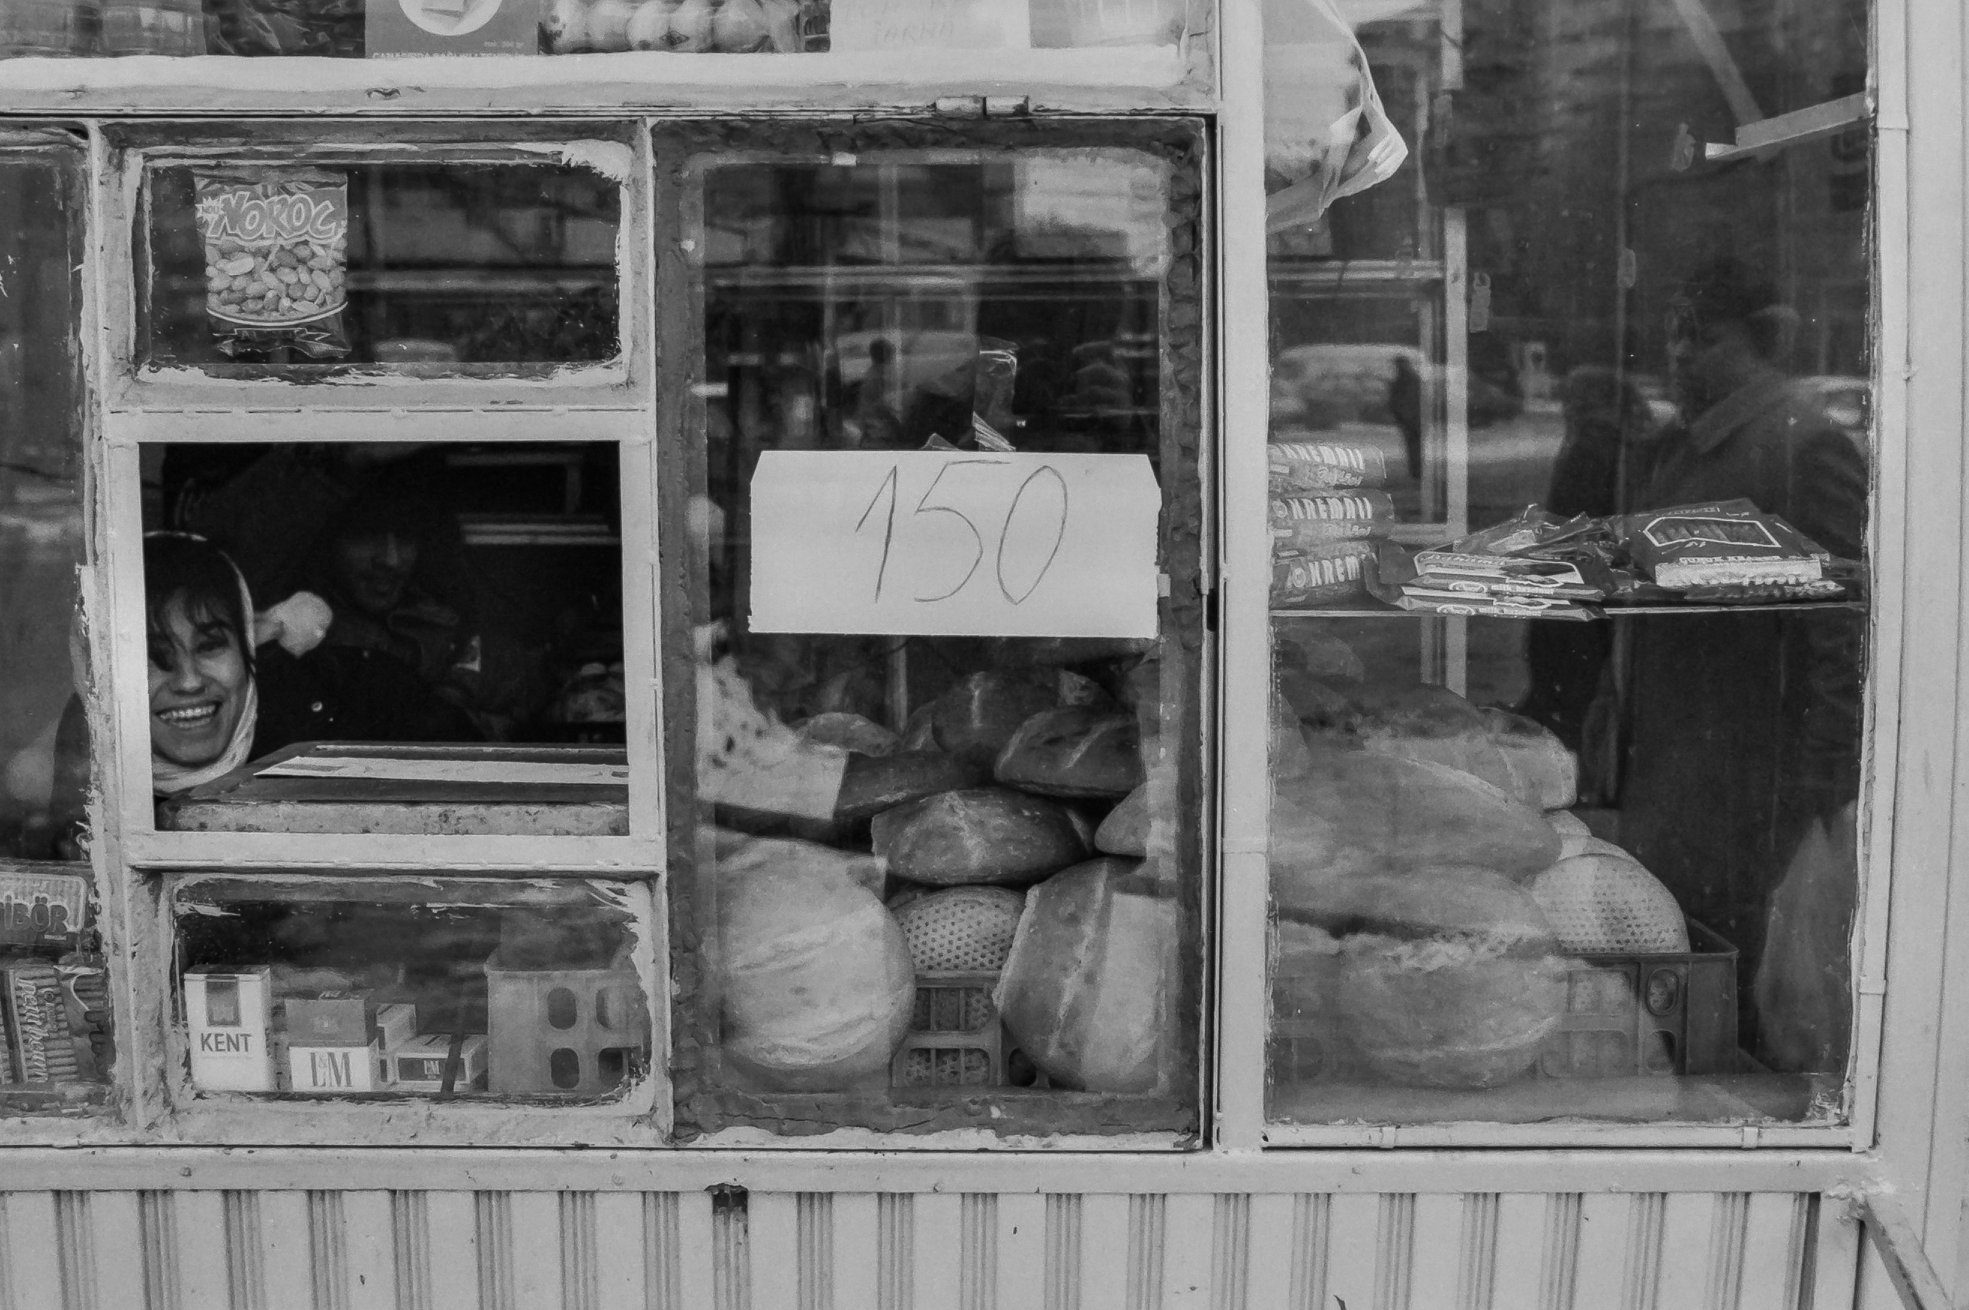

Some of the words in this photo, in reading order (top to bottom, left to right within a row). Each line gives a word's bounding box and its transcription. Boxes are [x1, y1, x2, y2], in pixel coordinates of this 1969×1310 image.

[206, 191, 336, 239] NOROC
[856, 459, 1068, 605] 150
[201, 1032, 253, 1052] KENT
[308, 1052, 354, 1088] L&M
